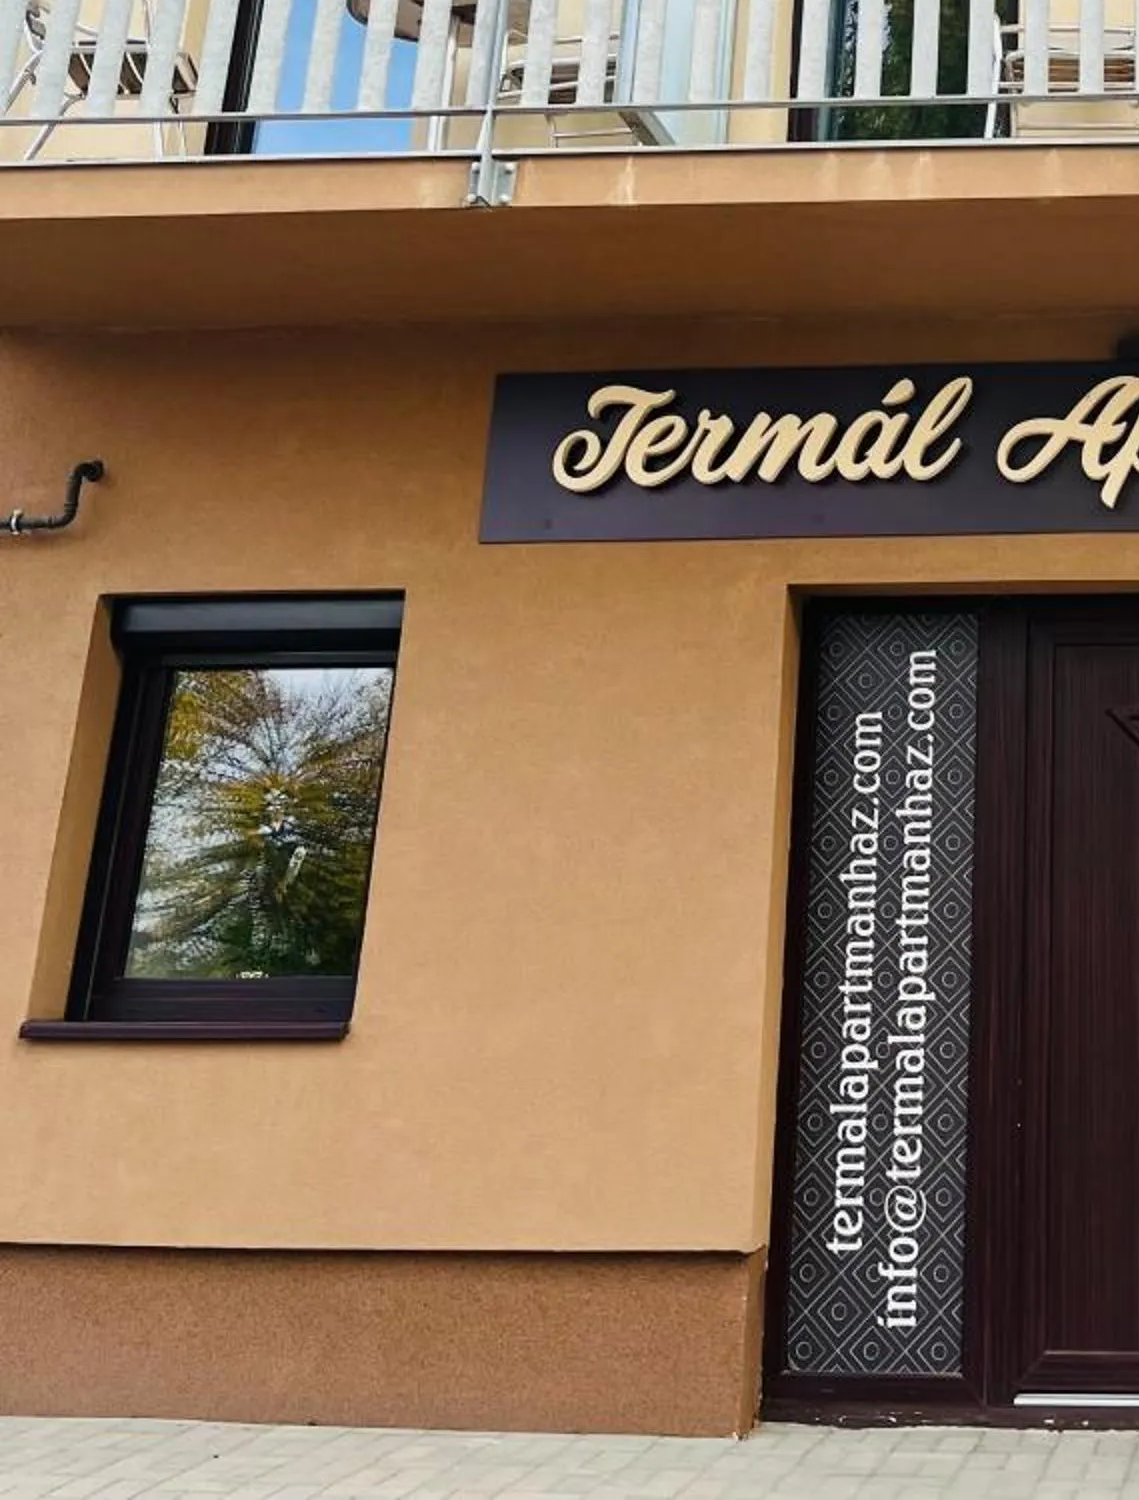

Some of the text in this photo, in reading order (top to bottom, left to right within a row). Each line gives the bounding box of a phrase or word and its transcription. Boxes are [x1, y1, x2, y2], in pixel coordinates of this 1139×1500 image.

[551, 376, 974, 493] Termál
[827, 710, 882, 1253] termalapartmanhaz.com
[877, 648, 937, 1329] info@termalapartmanhaz.com
